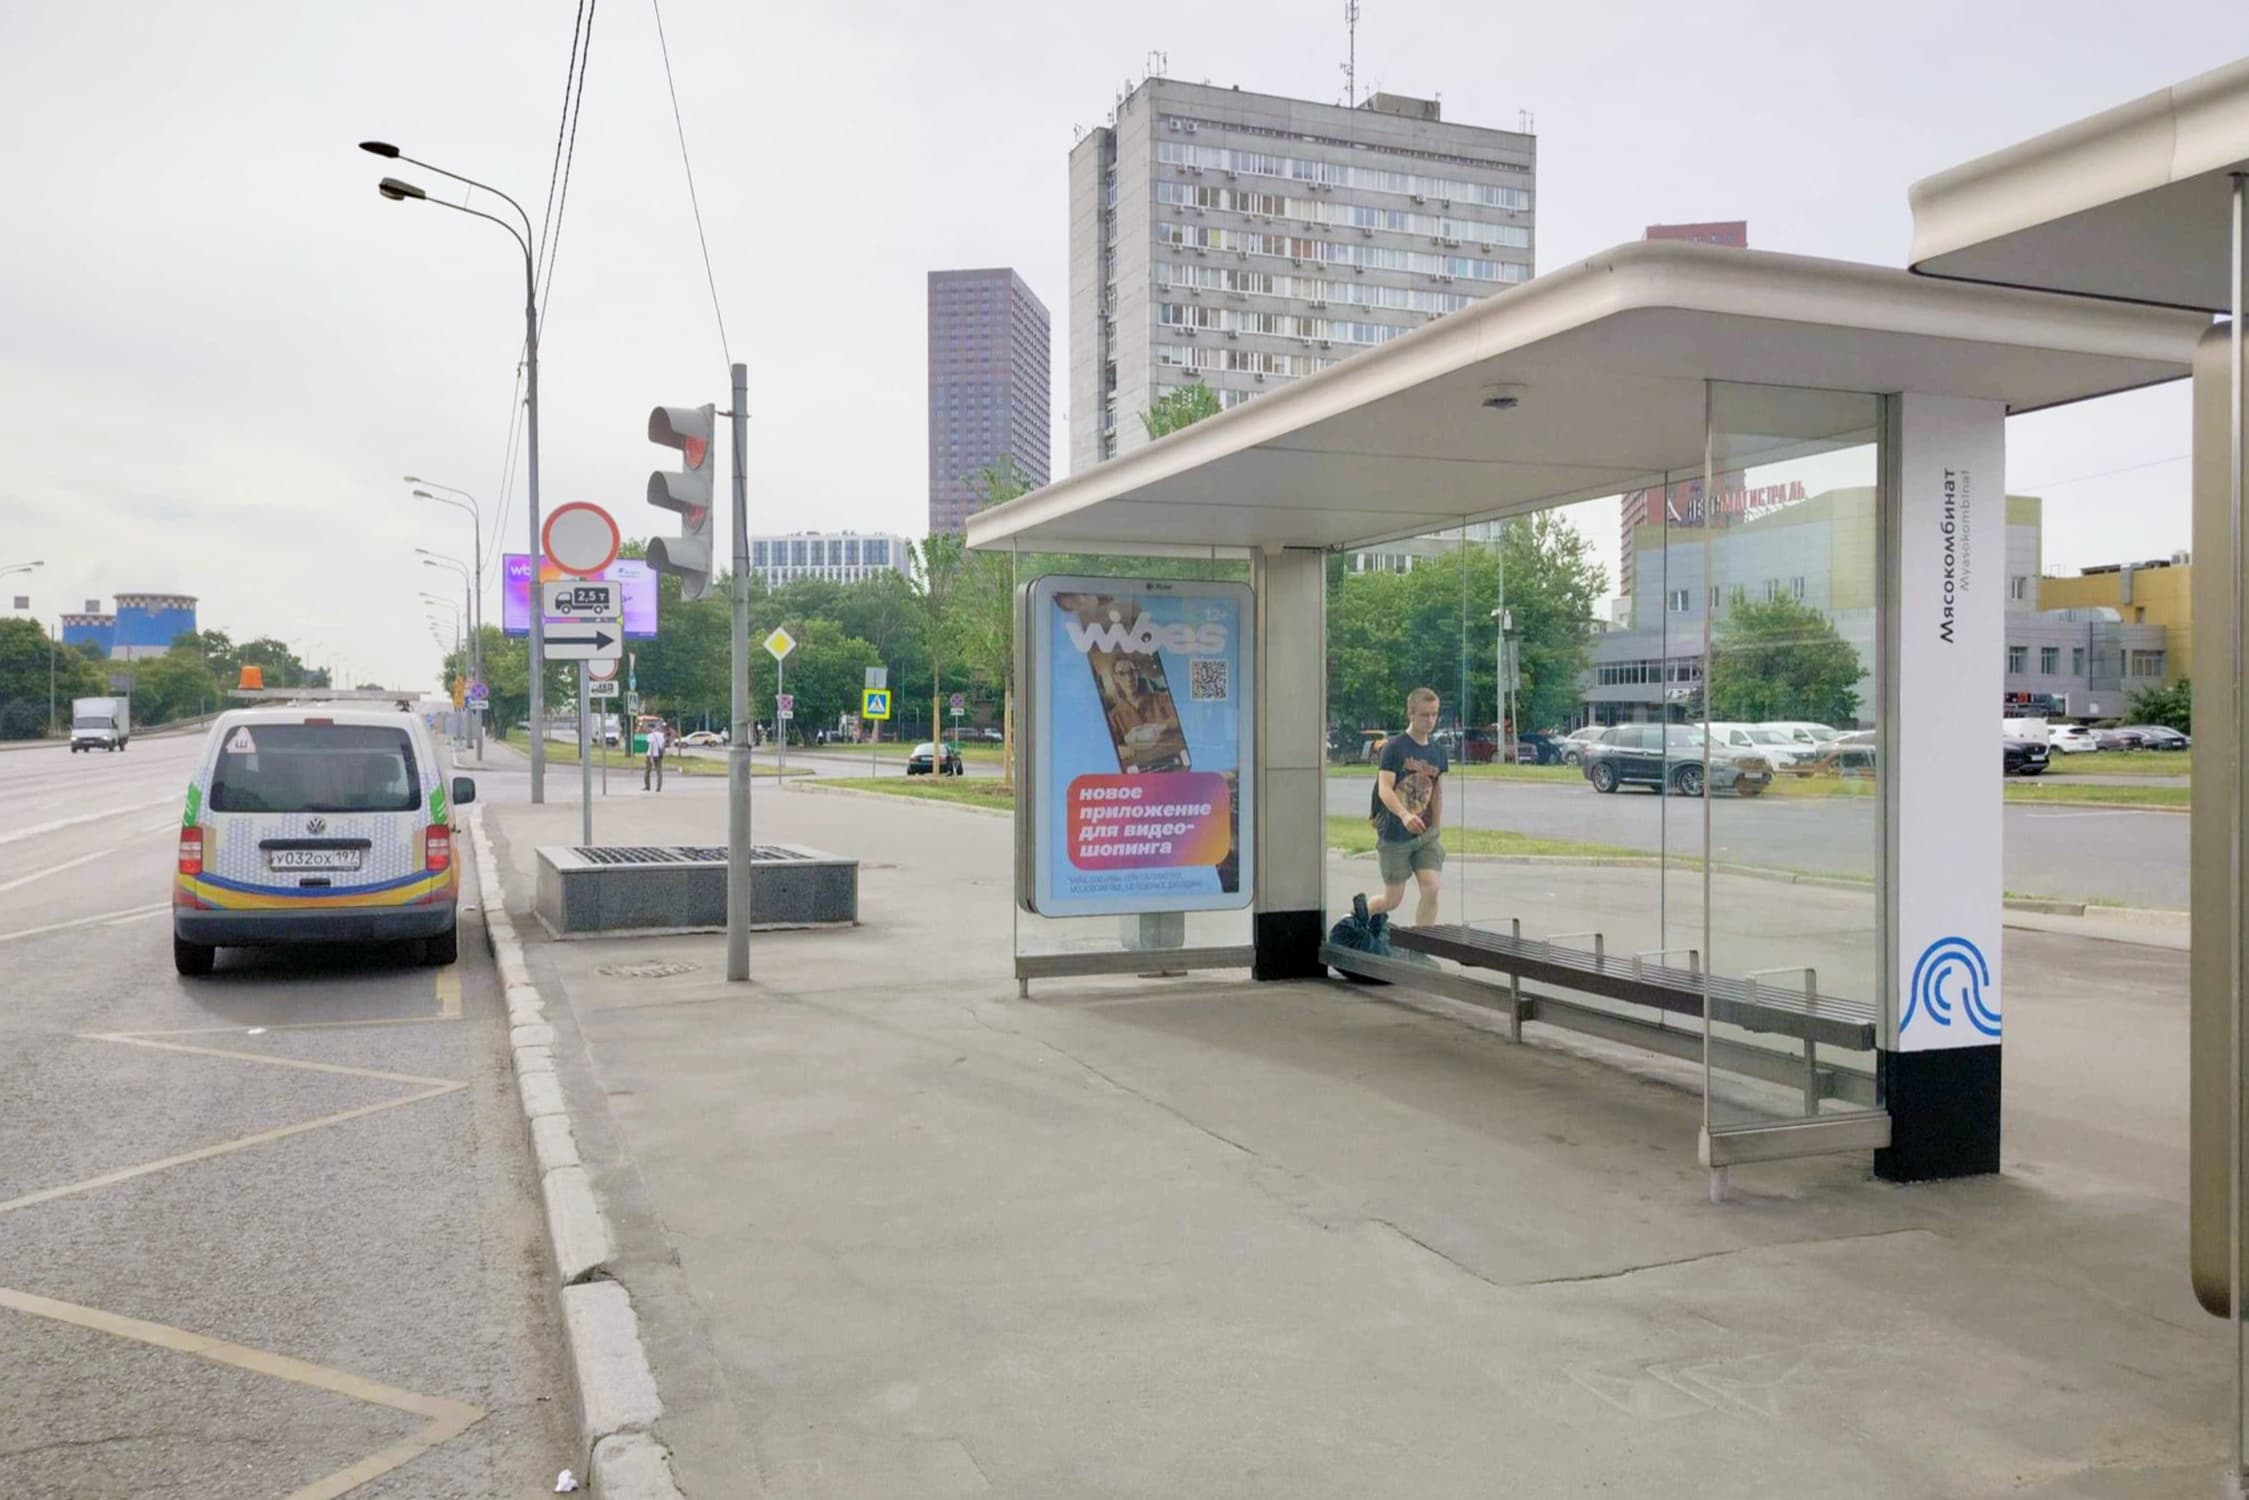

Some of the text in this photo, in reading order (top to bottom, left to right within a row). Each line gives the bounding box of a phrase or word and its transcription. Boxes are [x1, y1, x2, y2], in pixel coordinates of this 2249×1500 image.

[1960, 470, 1971, 592] Myasokombinat
[1940, 467, 1955, 644] Мясокомбинат
[577, 591, 596, 602] 2,5
[1065, 610, 1229, 654] vibes
[1079, 787, 1144, 801] новое
[1080, 803, 1213, 823] приложение
[1079, 822, 1196, 841] для видео-
[1079, 841, 1173, 857] шопинга
